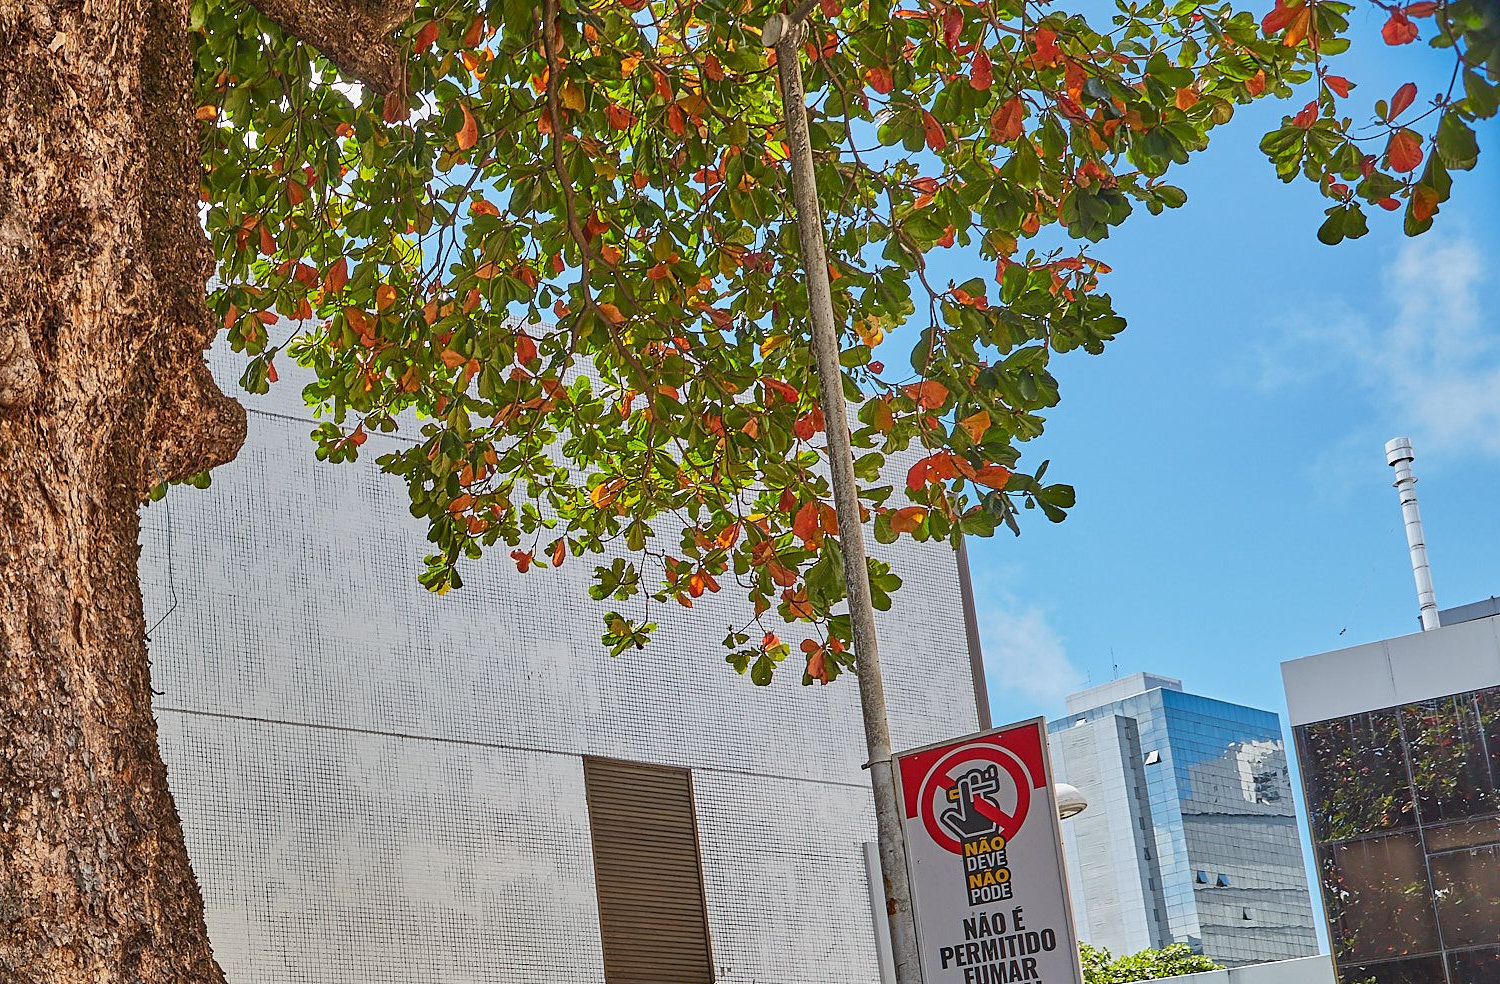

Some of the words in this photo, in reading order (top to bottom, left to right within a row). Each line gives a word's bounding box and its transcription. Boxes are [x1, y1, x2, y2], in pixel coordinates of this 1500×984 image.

[964, 836, 1005, 857] NÃO
[967, 850, 1006, 872] DEVE
[969, 868, 1009, 889] NÃO
[971, 882, 1011, 904] PODE
[963, 911, 1007, 941] NÃO
[1013, 906, 1026, 930] É
[940, 928, 1056, 970] PERMITIDO
